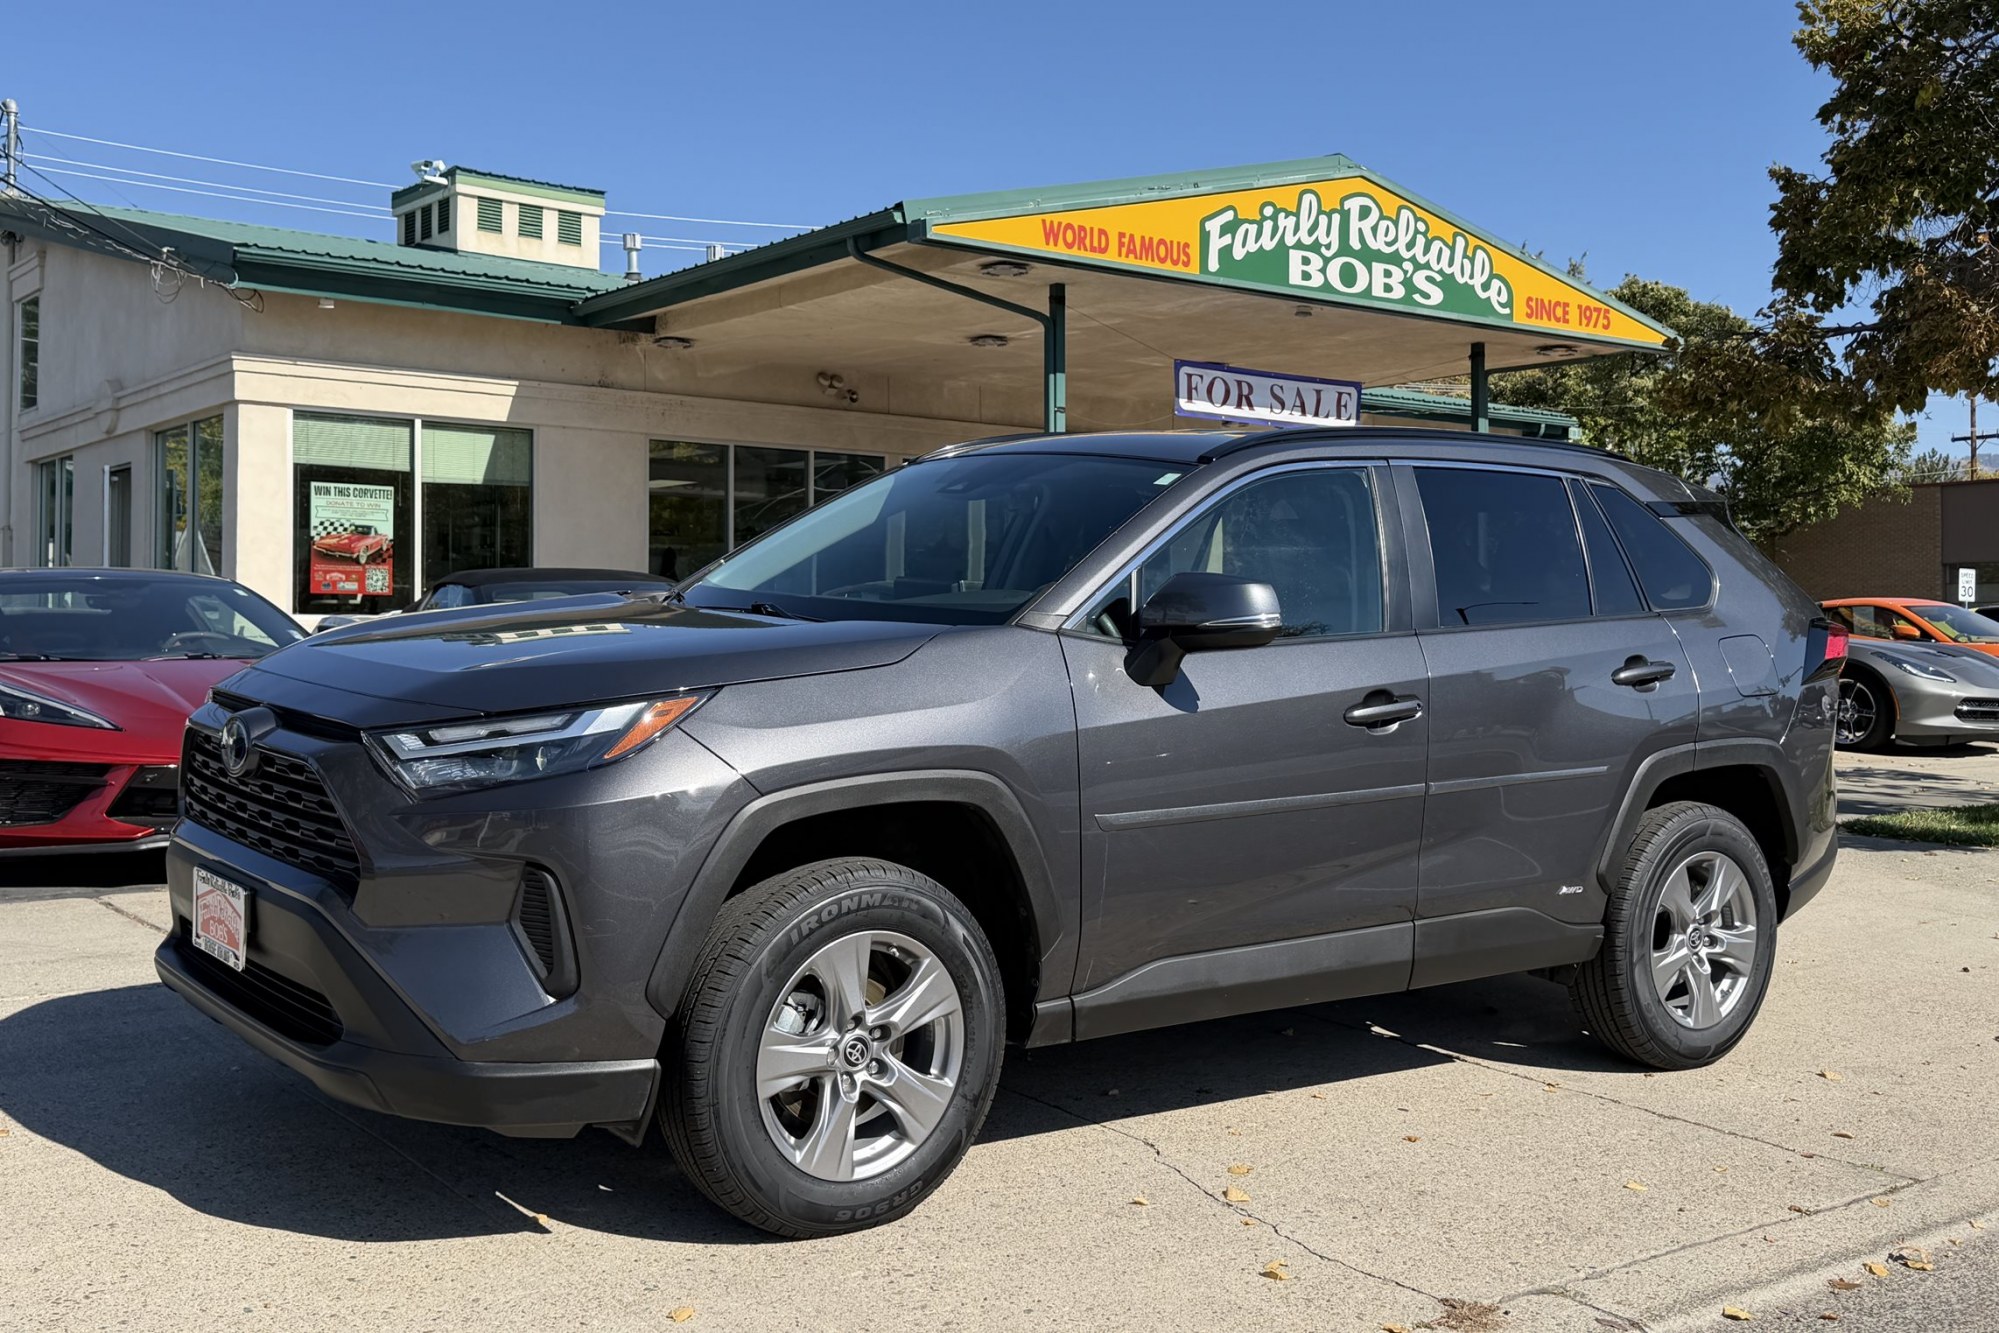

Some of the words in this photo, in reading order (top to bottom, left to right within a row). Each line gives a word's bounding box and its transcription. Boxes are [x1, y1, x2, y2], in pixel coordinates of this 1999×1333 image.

[1041, 218, 1110, 255] WORLD
[1118, 231, 1191, 268] FAMOUS
[1204, 192, 1341, 273] Fairly
[1344, 196, 1511, 314] Reliable
[1288, 249, 1444, 306] BOB'S
[1525, 295, 1570, 324] SINCE
[1577, 303, 1611, 330] 1975
[1184, 372, 1256, 412] FOR
[1269, 383, 1352, 421] SALE
[313, 485, 332, 497] WIN
[333, 486, 351, 498] THIS
[352, 487, 393, 500] CORVETTE!
[1960, 585, 1974, 598] 30
[789, 892, 920, 946] IRONMAN
